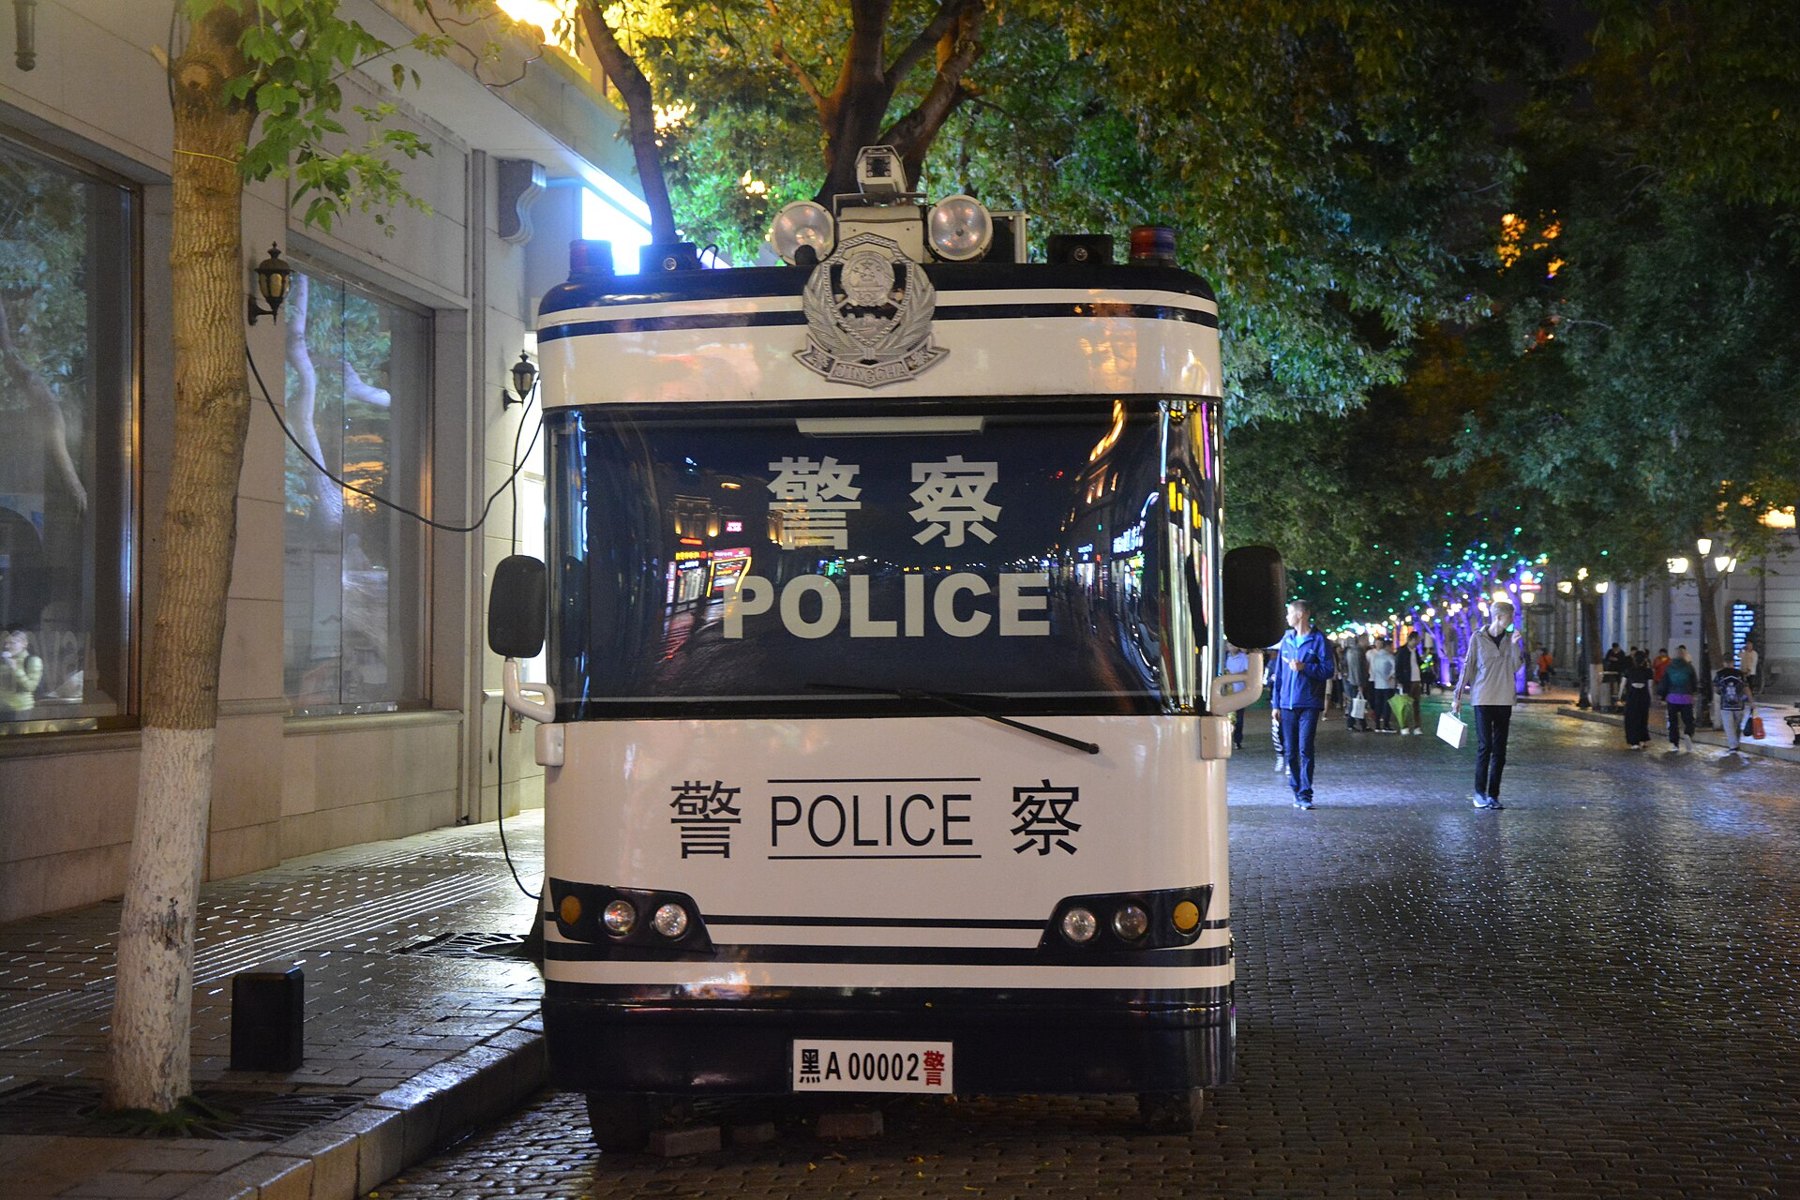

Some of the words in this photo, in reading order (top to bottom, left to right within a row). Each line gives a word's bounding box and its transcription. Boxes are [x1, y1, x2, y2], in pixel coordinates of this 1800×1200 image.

[723, 572, 1051, 639] POLICE
[670, 780, 742, 859] 警
[770, 793, 973, 848] POLICE
[1011, 778, 1082, 856] 察
